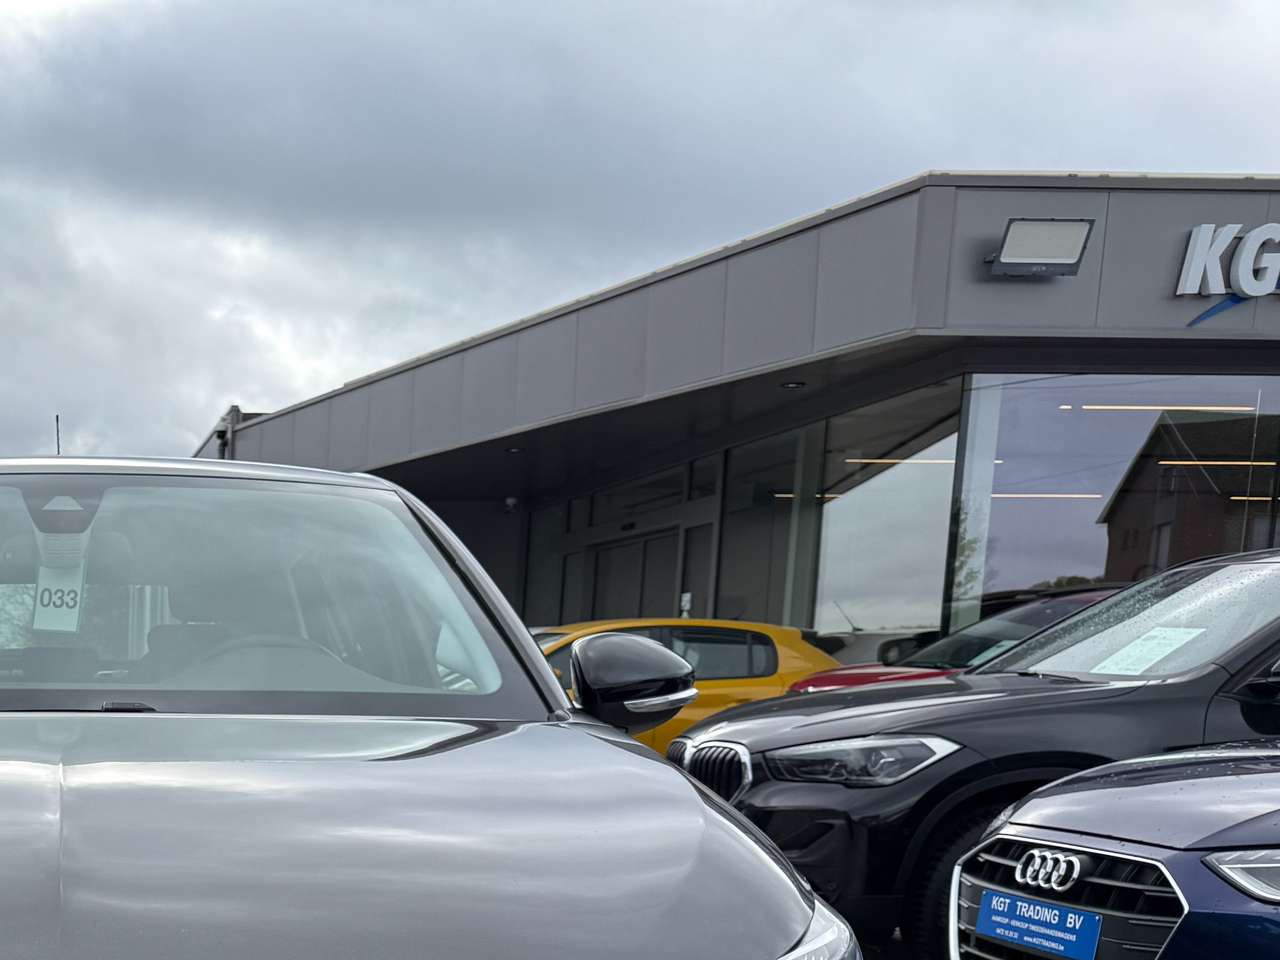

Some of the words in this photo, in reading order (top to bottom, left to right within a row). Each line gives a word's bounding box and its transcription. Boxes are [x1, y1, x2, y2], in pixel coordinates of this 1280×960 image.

[39, 588, 78, 609] 033
[991, 896, 1011, 913] KGT
[1016, 901, 1060, 924] TRADING
[1066, 913, 1084, 930] BV
